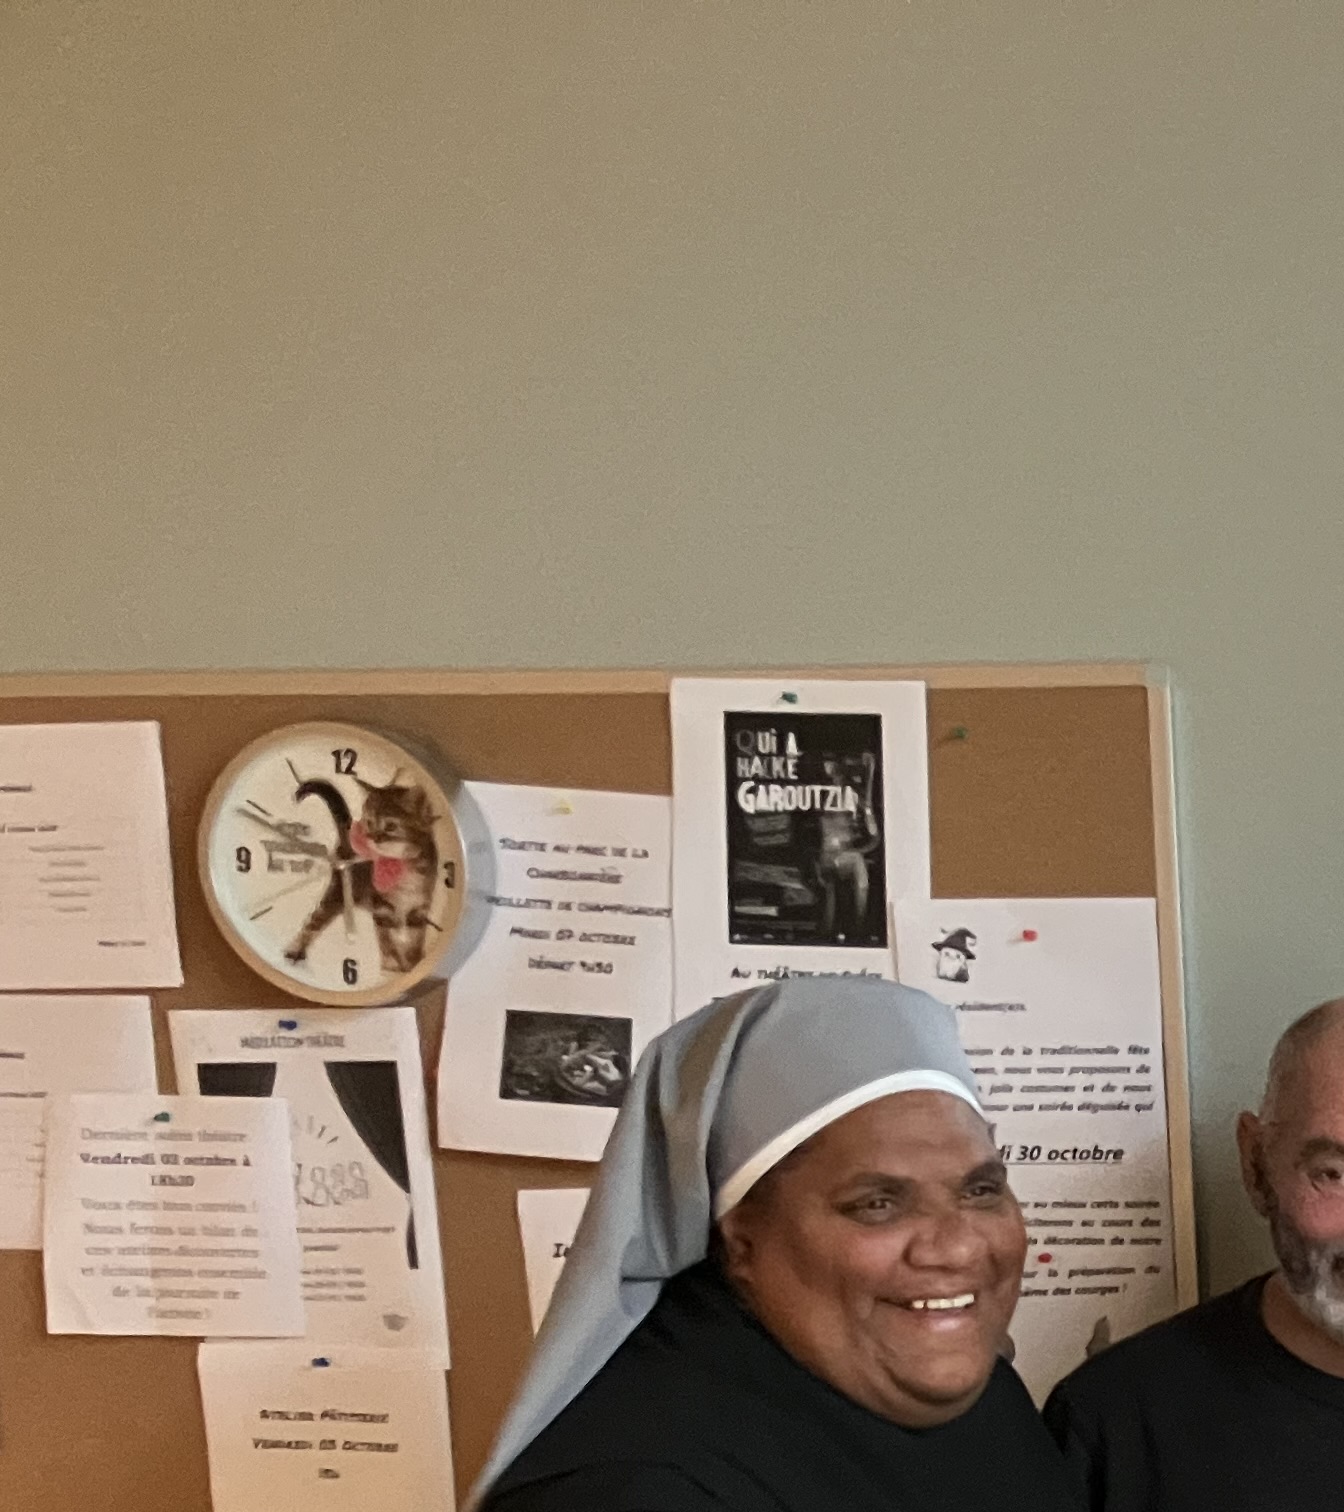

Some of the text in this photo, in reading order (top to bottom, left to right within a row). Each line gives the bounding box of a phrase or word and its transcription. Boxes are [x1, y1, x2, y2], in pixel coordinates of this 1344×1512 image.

[785, 731, 803, 755] A
[331, 748, 358, 776] 12
[737, 781, 859, 816] GAROUTZIA
[235, 846, 252, 873] 9
[443, 860, 456, 889] 3
[342, 957, 358, 986] 6
[80, 1152, 156, 1166] Vendredi
[1017, 1145, 1042, 1161] 30
[1047, 1145, 1125, 1161] octobre
